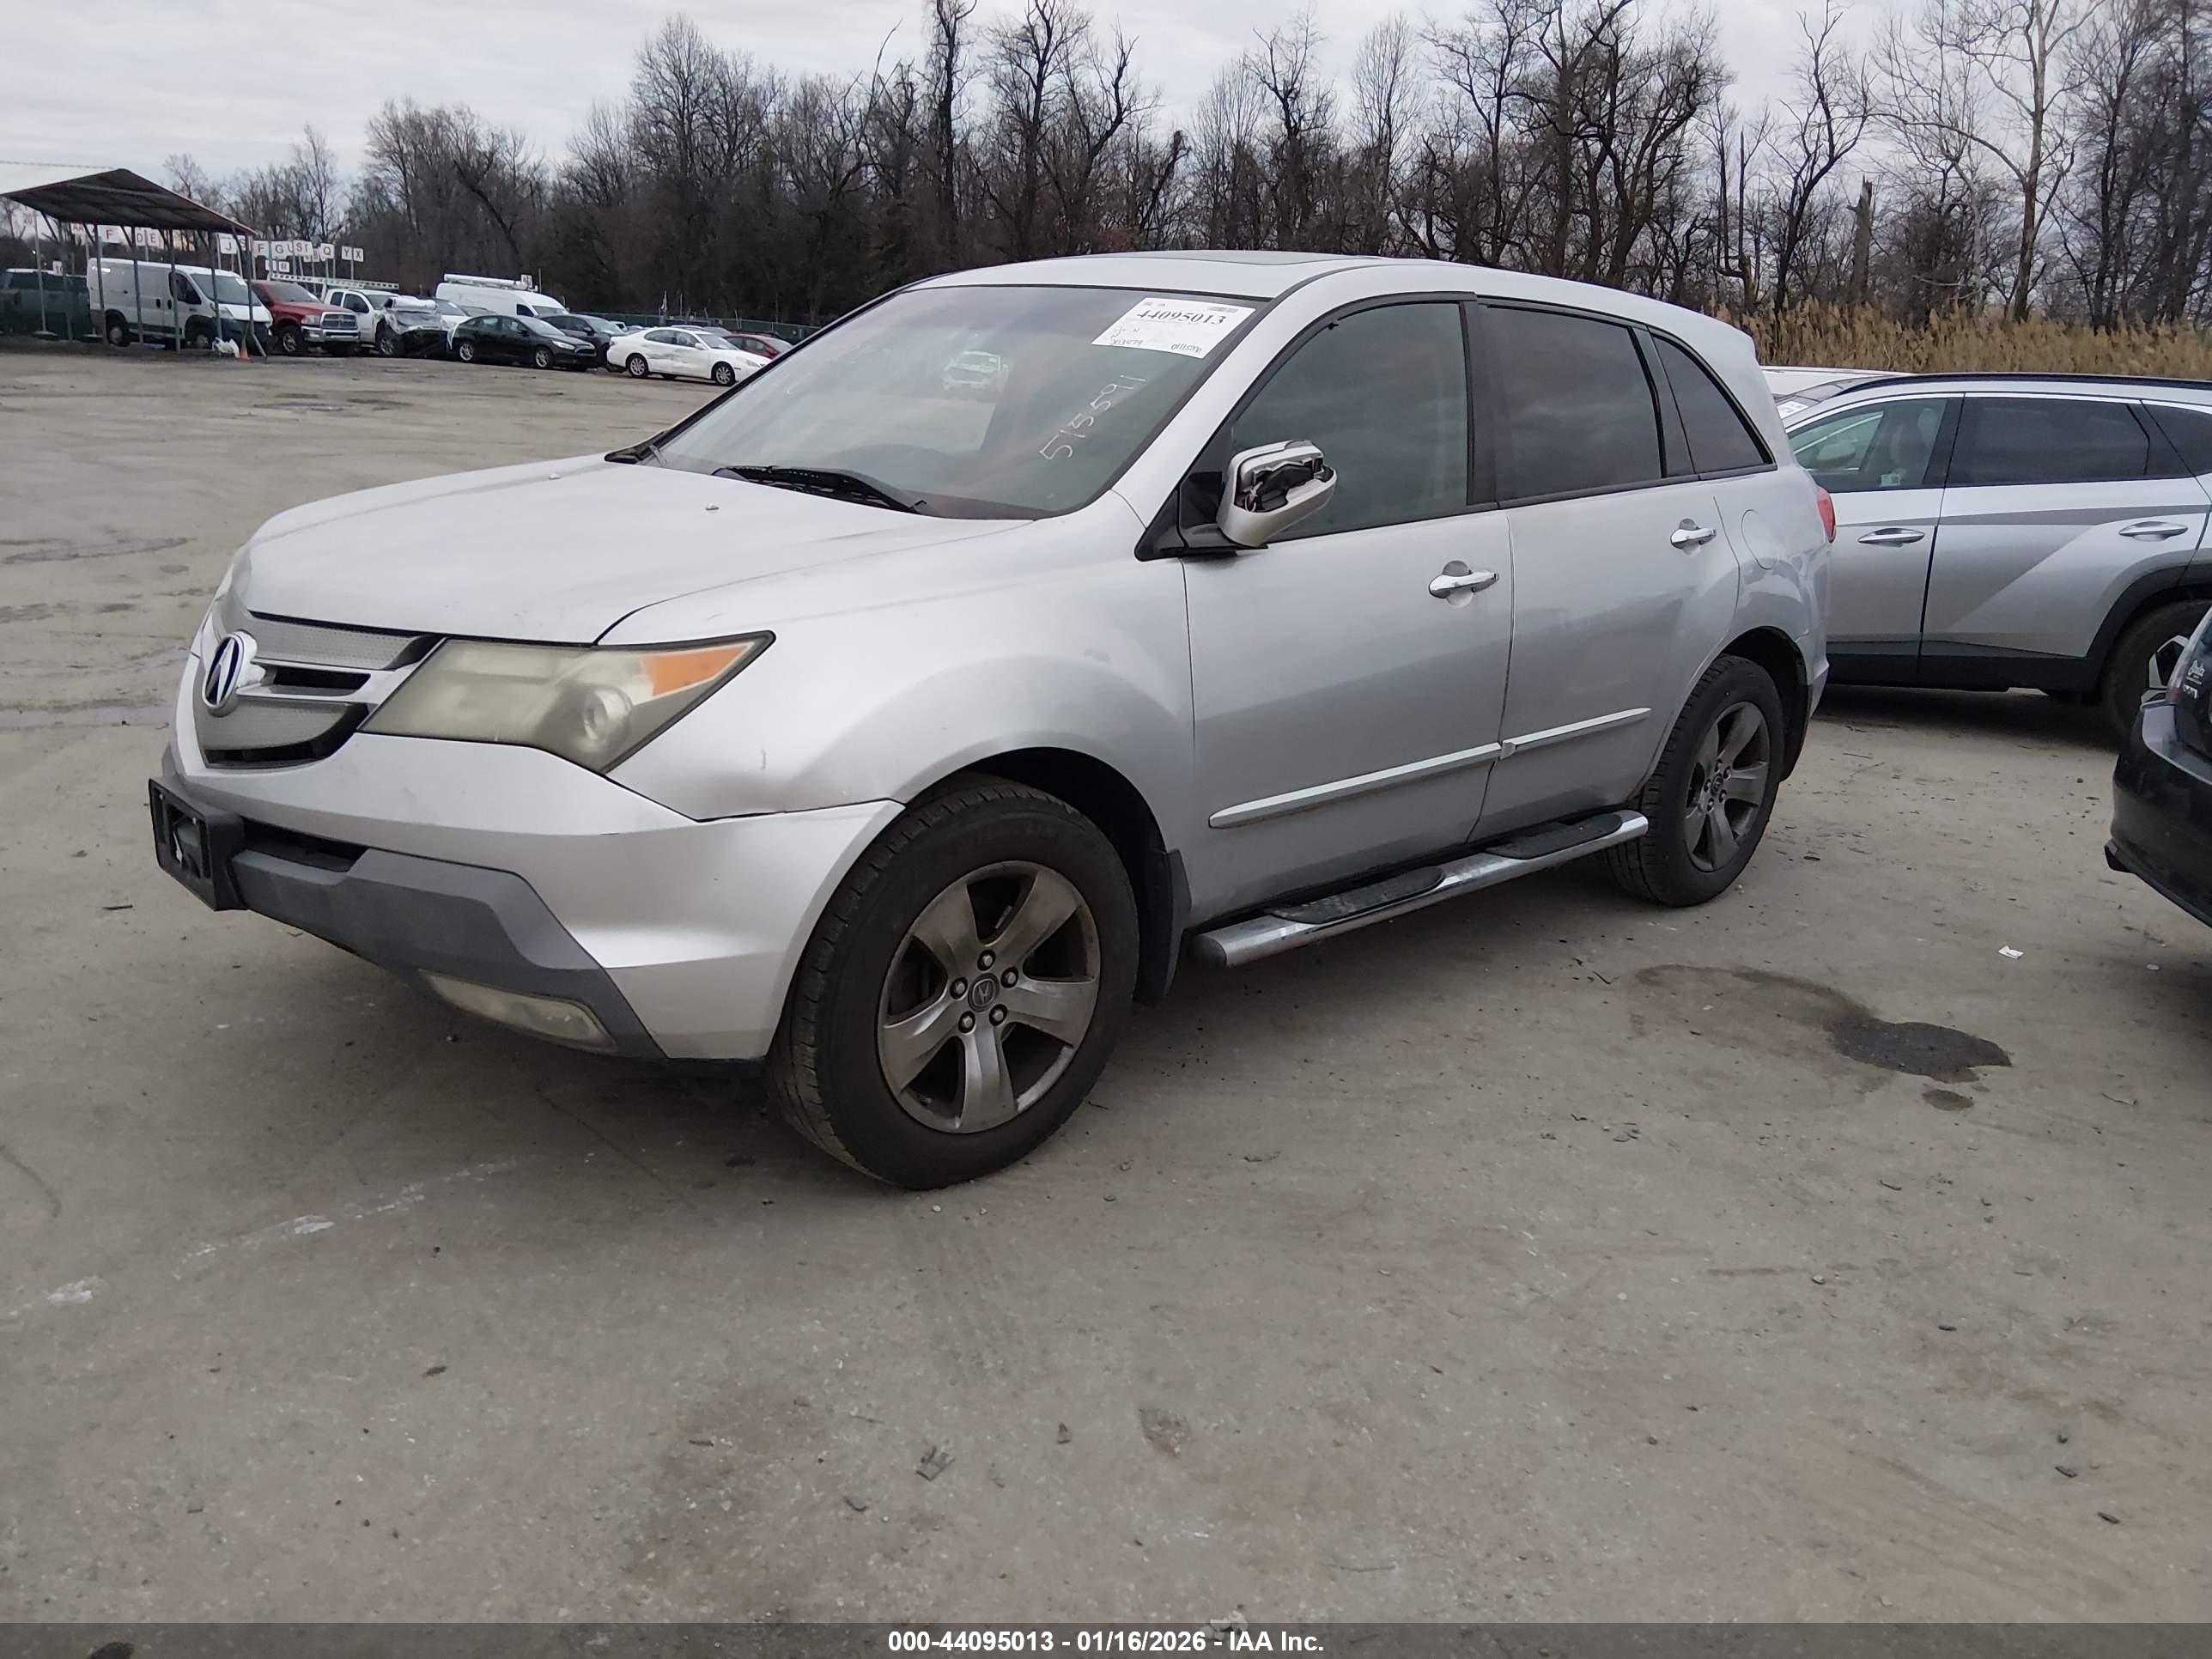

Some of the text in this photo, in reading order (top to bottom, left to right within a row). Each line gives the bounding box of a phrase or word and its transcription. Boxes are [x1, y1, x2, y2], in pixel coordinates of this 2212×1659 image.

[106, 228, 113, 240] F
[137, 233, 143, 243] D
[150, 233, 157, 243] E
[225, 241, 232, 251] J
[258, 243, 264, 253] F
[275, 244, 284, 254] G
[295, 242, 303, 252] S
[323, 246, 331, 256] Q
[343, 247, 350, 258] Y
[356, 250, 362, 259] X
[1136, 309, 1227, 325] 44095013
[1038, 374, 1146, 460] 515591
